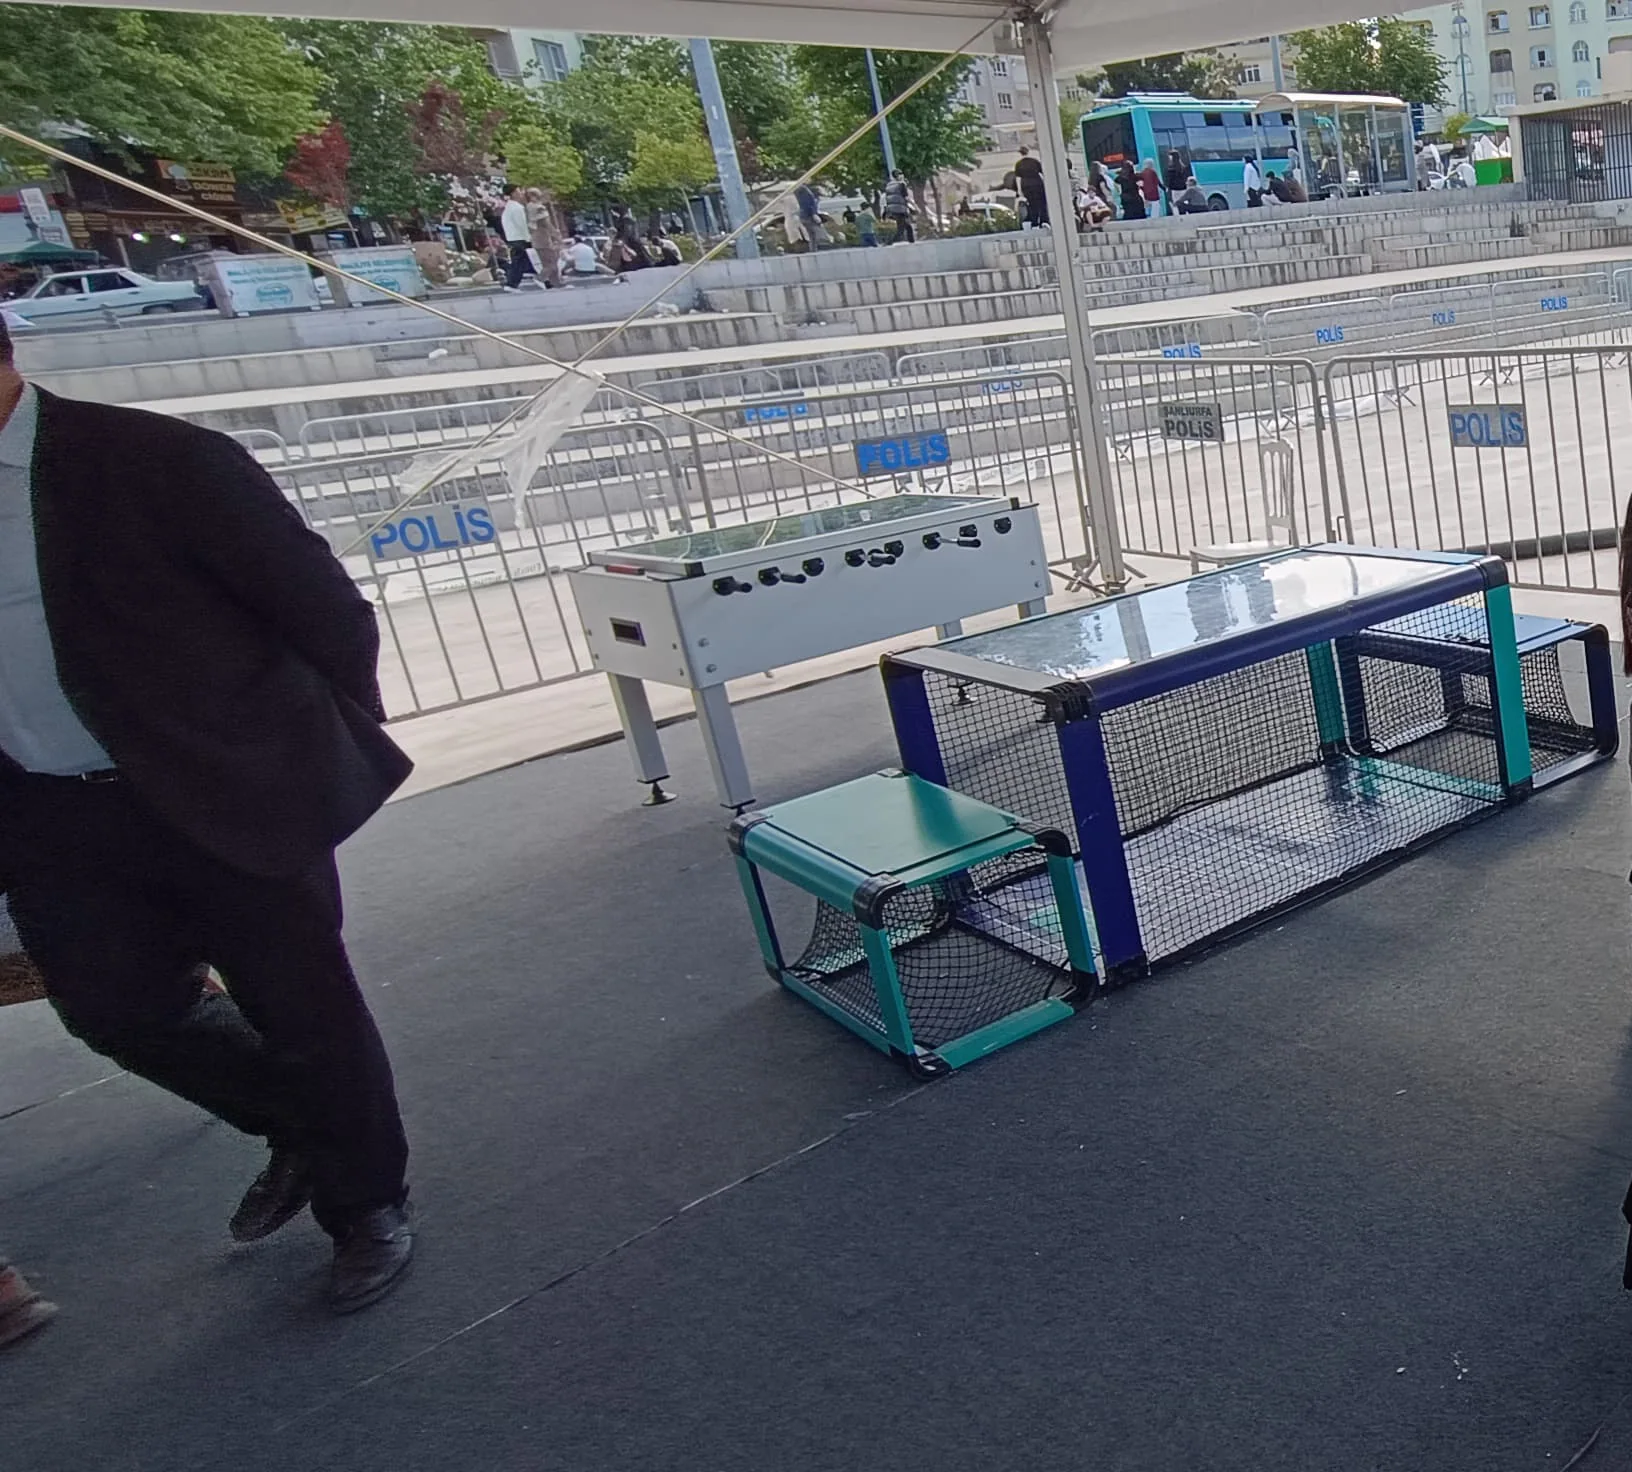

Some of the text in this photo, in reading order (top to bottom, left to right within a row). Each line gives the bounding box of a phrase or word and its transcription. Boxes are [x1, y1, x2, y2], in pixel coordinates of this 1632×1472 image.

[1541, 297, 1568, 311] POLİS
[1433, 311, 1456, 326] POLİS
[1316, 324, 1344, 343] POLİS
[1165, 420, 1214, 438] POLİS
[1450, 406, 1525, 446] POLİS
[368, 505, 495, 558] POLİS
